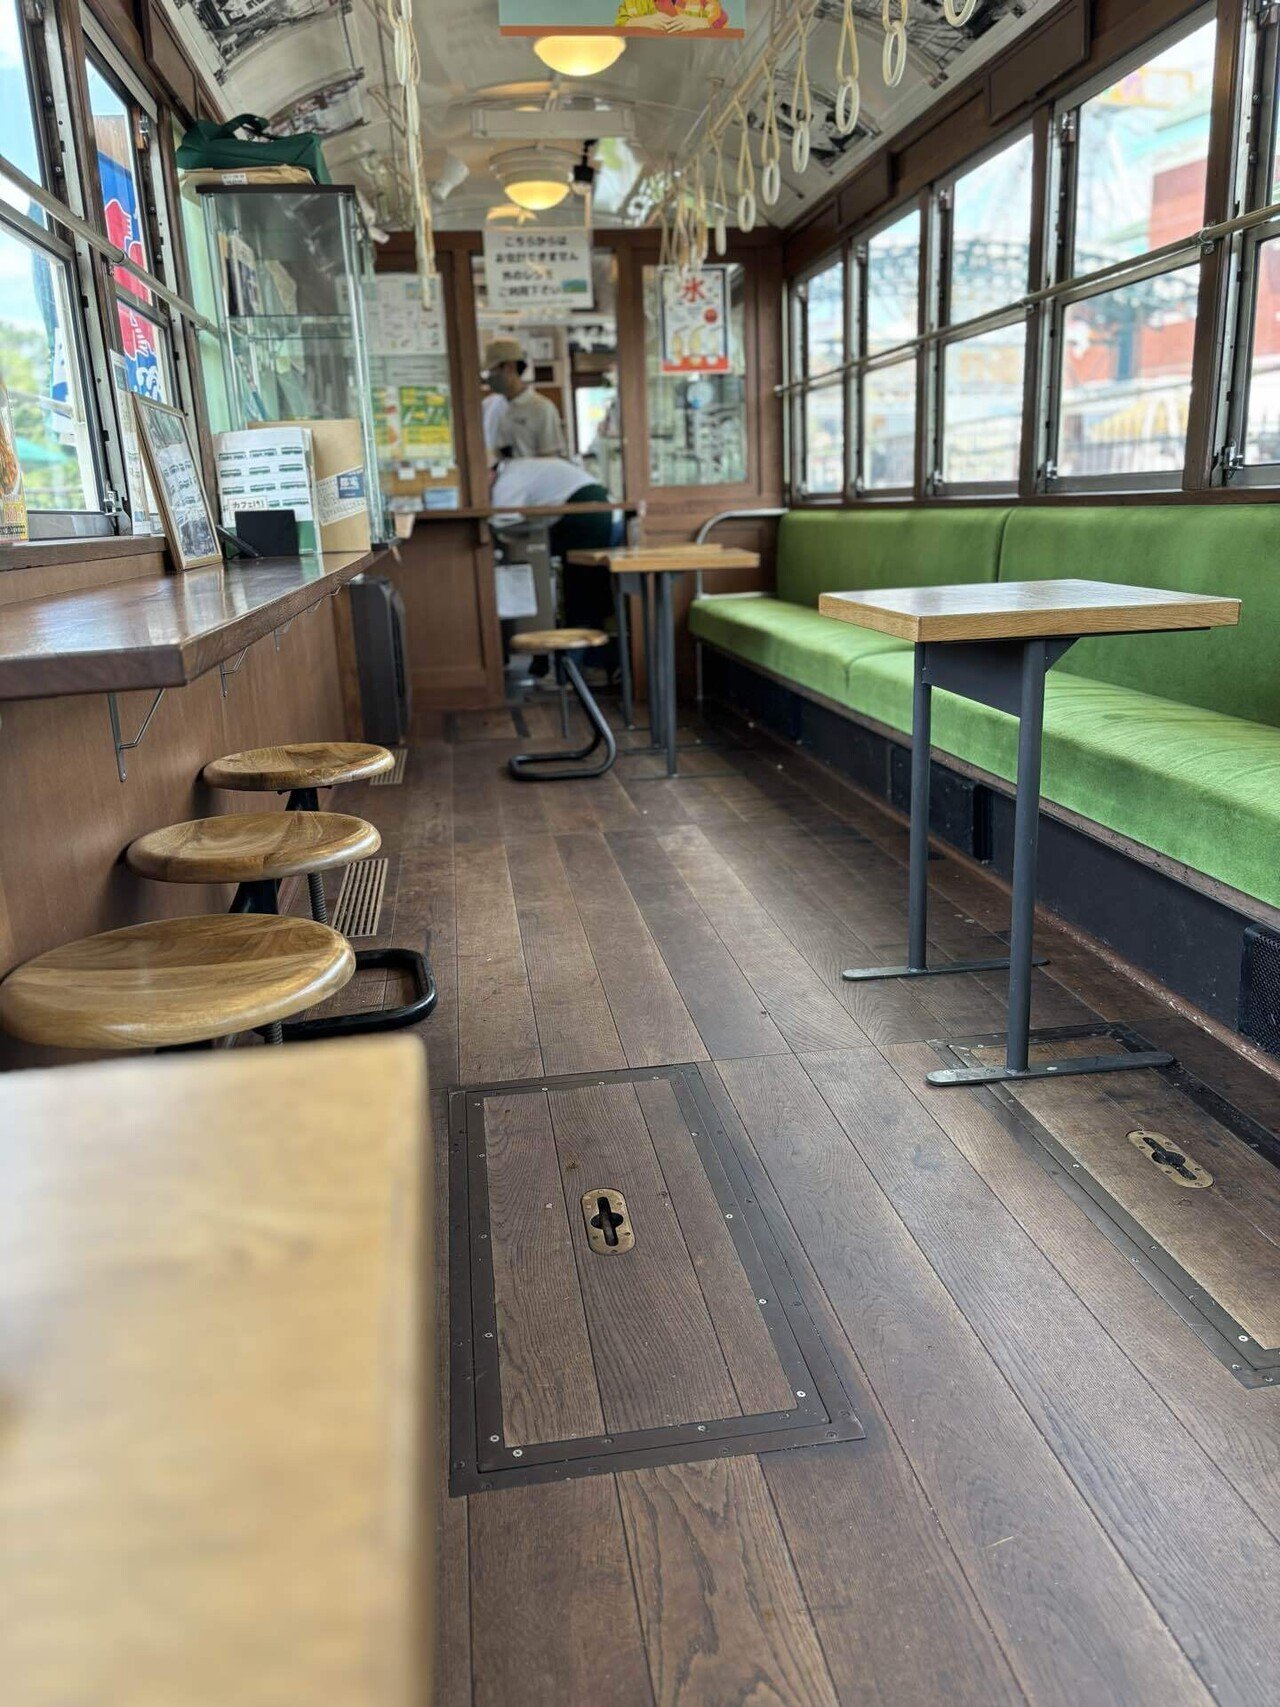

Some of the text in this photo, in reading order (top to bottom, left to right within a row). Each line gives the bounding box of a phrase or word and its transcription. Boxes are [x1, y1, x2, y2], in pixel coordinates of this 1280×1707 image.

[504, 236, 568, 248] こちらからは
[679, 276, 706, 303] 氷
